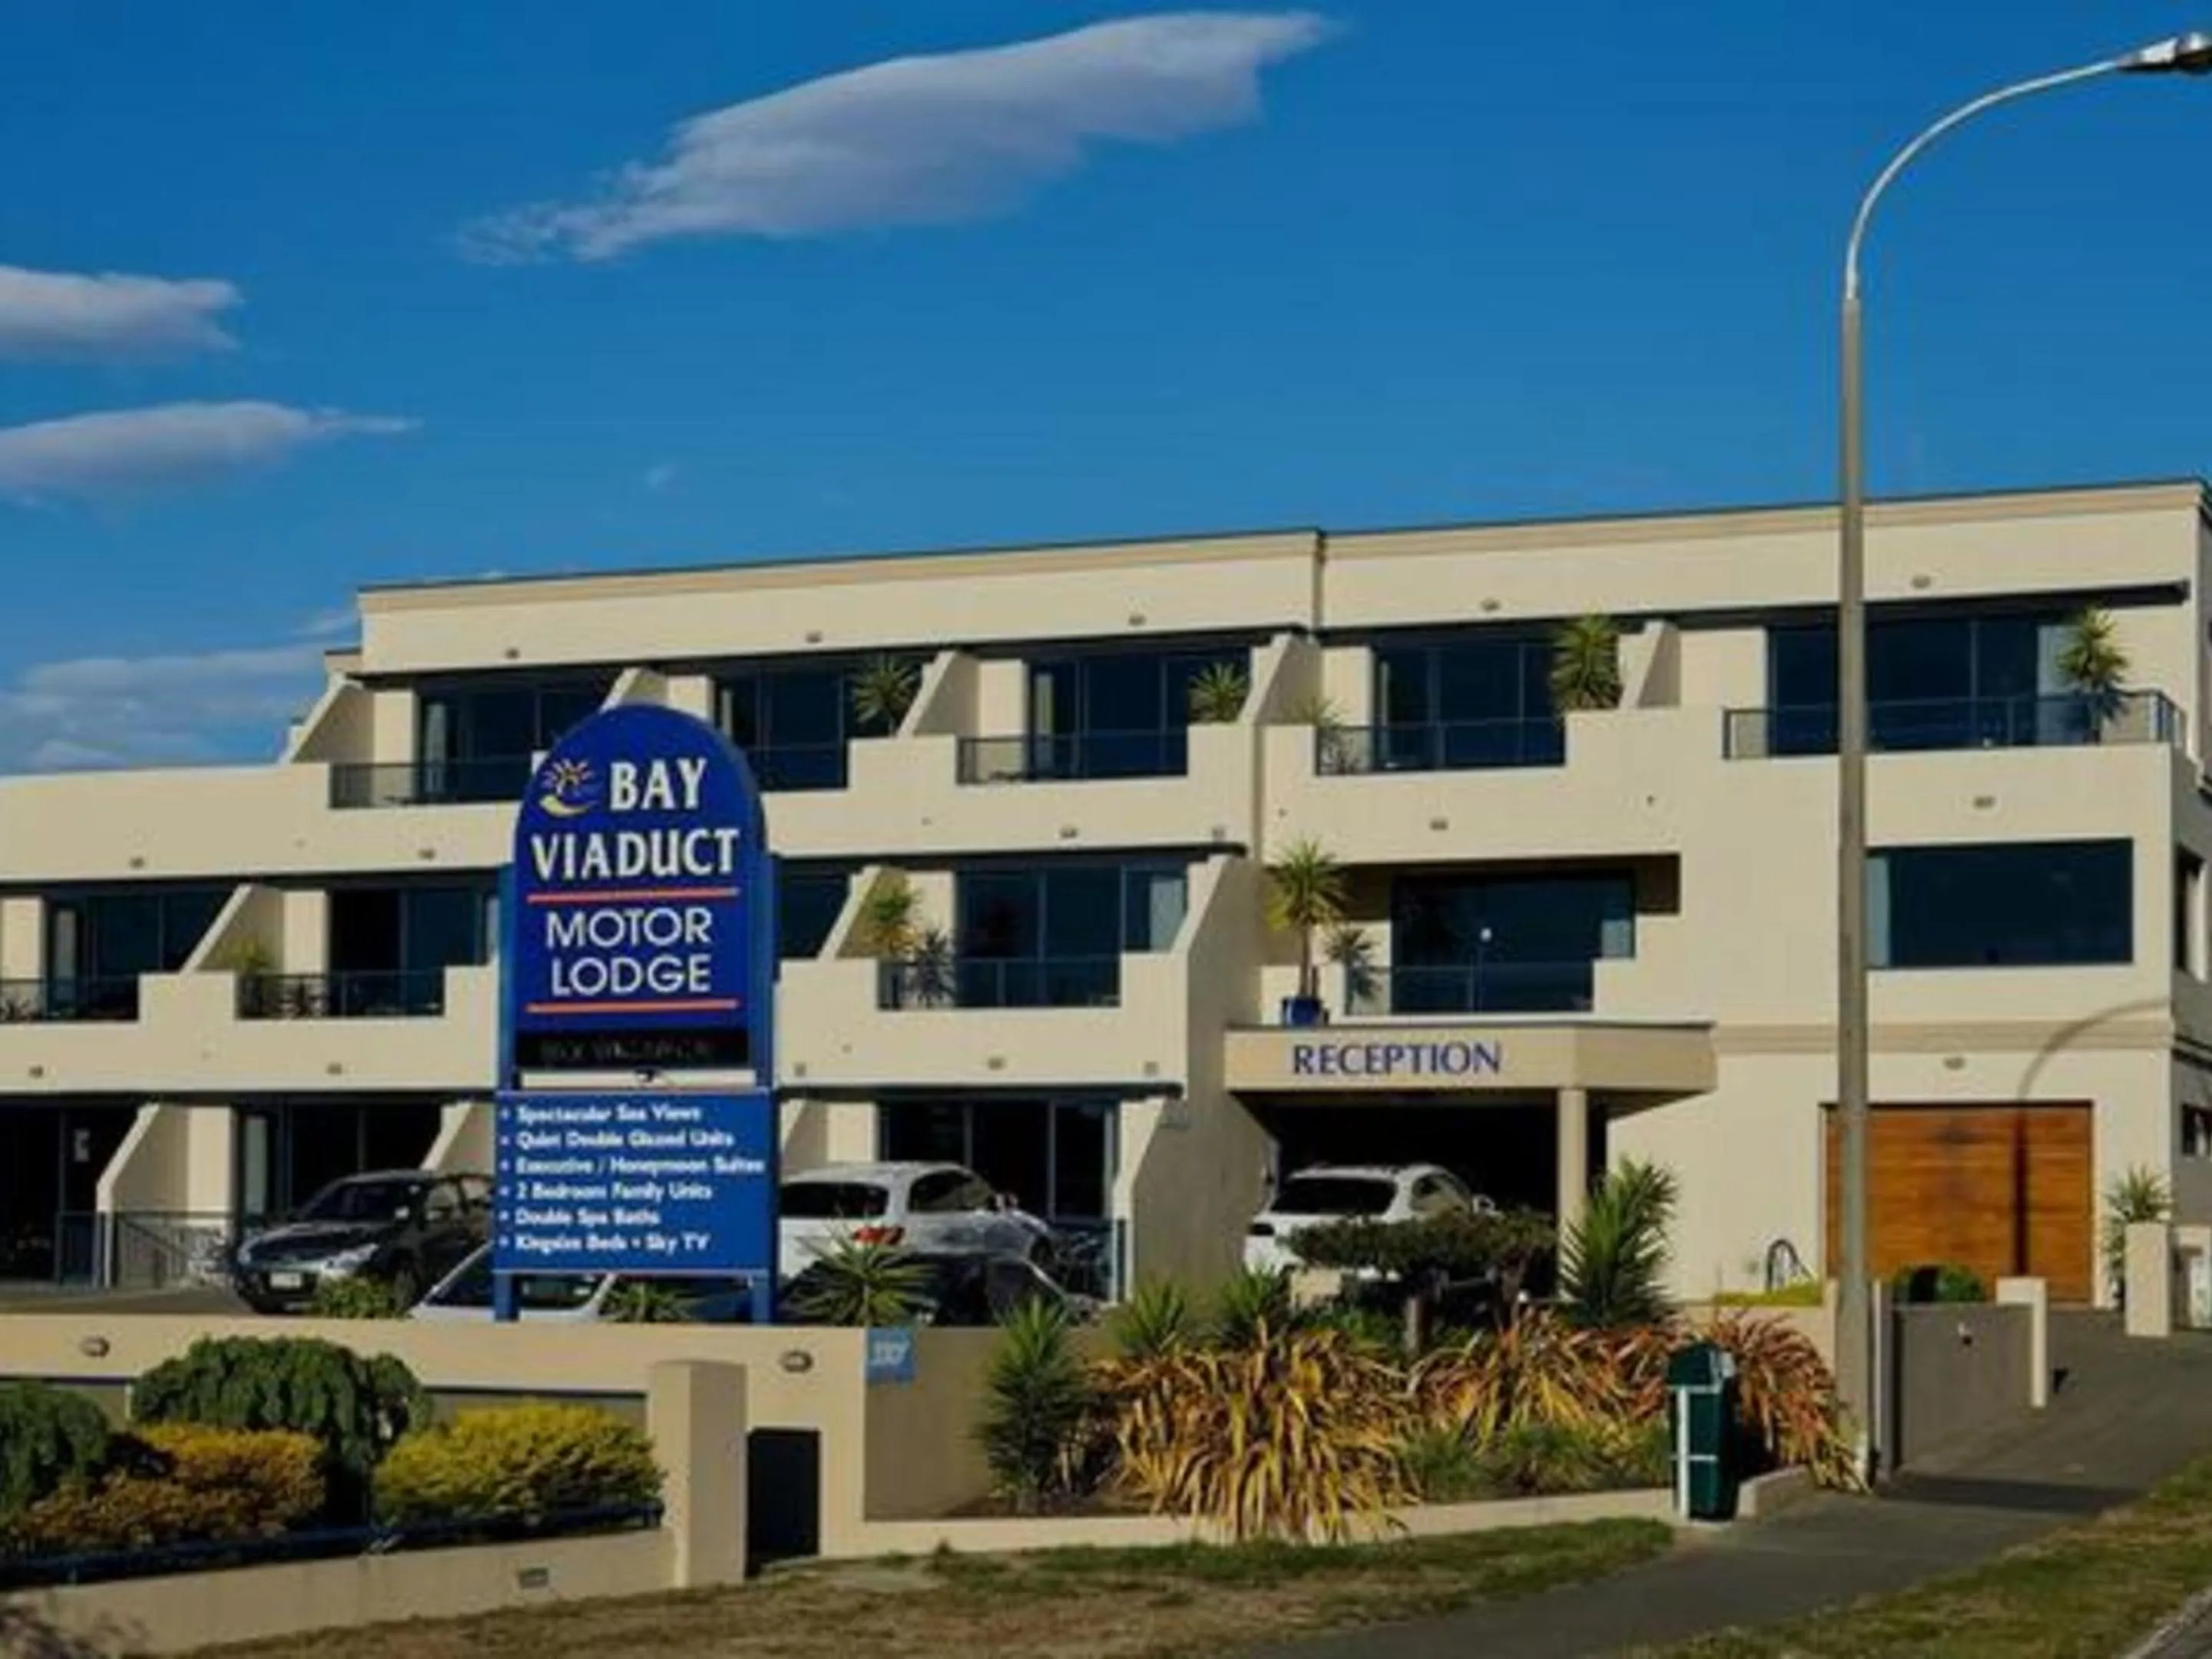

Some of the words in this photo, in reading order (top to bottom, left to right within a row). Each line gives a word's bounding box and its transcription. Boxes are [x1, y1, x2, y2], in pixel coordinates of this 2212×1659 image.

[609, 757, 708, 811] BAY
[531, 828, 739, 881] VIADUCT
[546, 907, 713, 949] MOTOR
[552, 955, 712, 995] LODGE
[1293, 1041, 1502, 1075] RECEPTION
[517, 1105, 612, 1126] Spectacular
[617, 1104, 647, 1121] Sea
[651, 1103, 703, 1121] Views
[516, 1131, 562, 1151] Quiet
[565, 1130, 624, 1148] Double
[690, 1130, 734, 1147] Units
[515, 1156, 595, 1175] Executive
[609, 1155, 708, 1177] Honeymoon
[714, 1154, 766, 1174] Suites
[517, 1182, 528, 1200] 2
[531, 1182, 608, 1200] Bedroom
[611, 1181, 665, 1203] Family
[667, 1181, 714, 1200] Units
[515, 1208, 572, 1226] Double
[577, 1207, 609, 1228] Spa
[613, 1207, 661, 1225] Baths
[585, 1233, 628, 1251] Beds
[644, 1233, 678, 1255] Sky
[680, 1232, 711, 1250] TV
